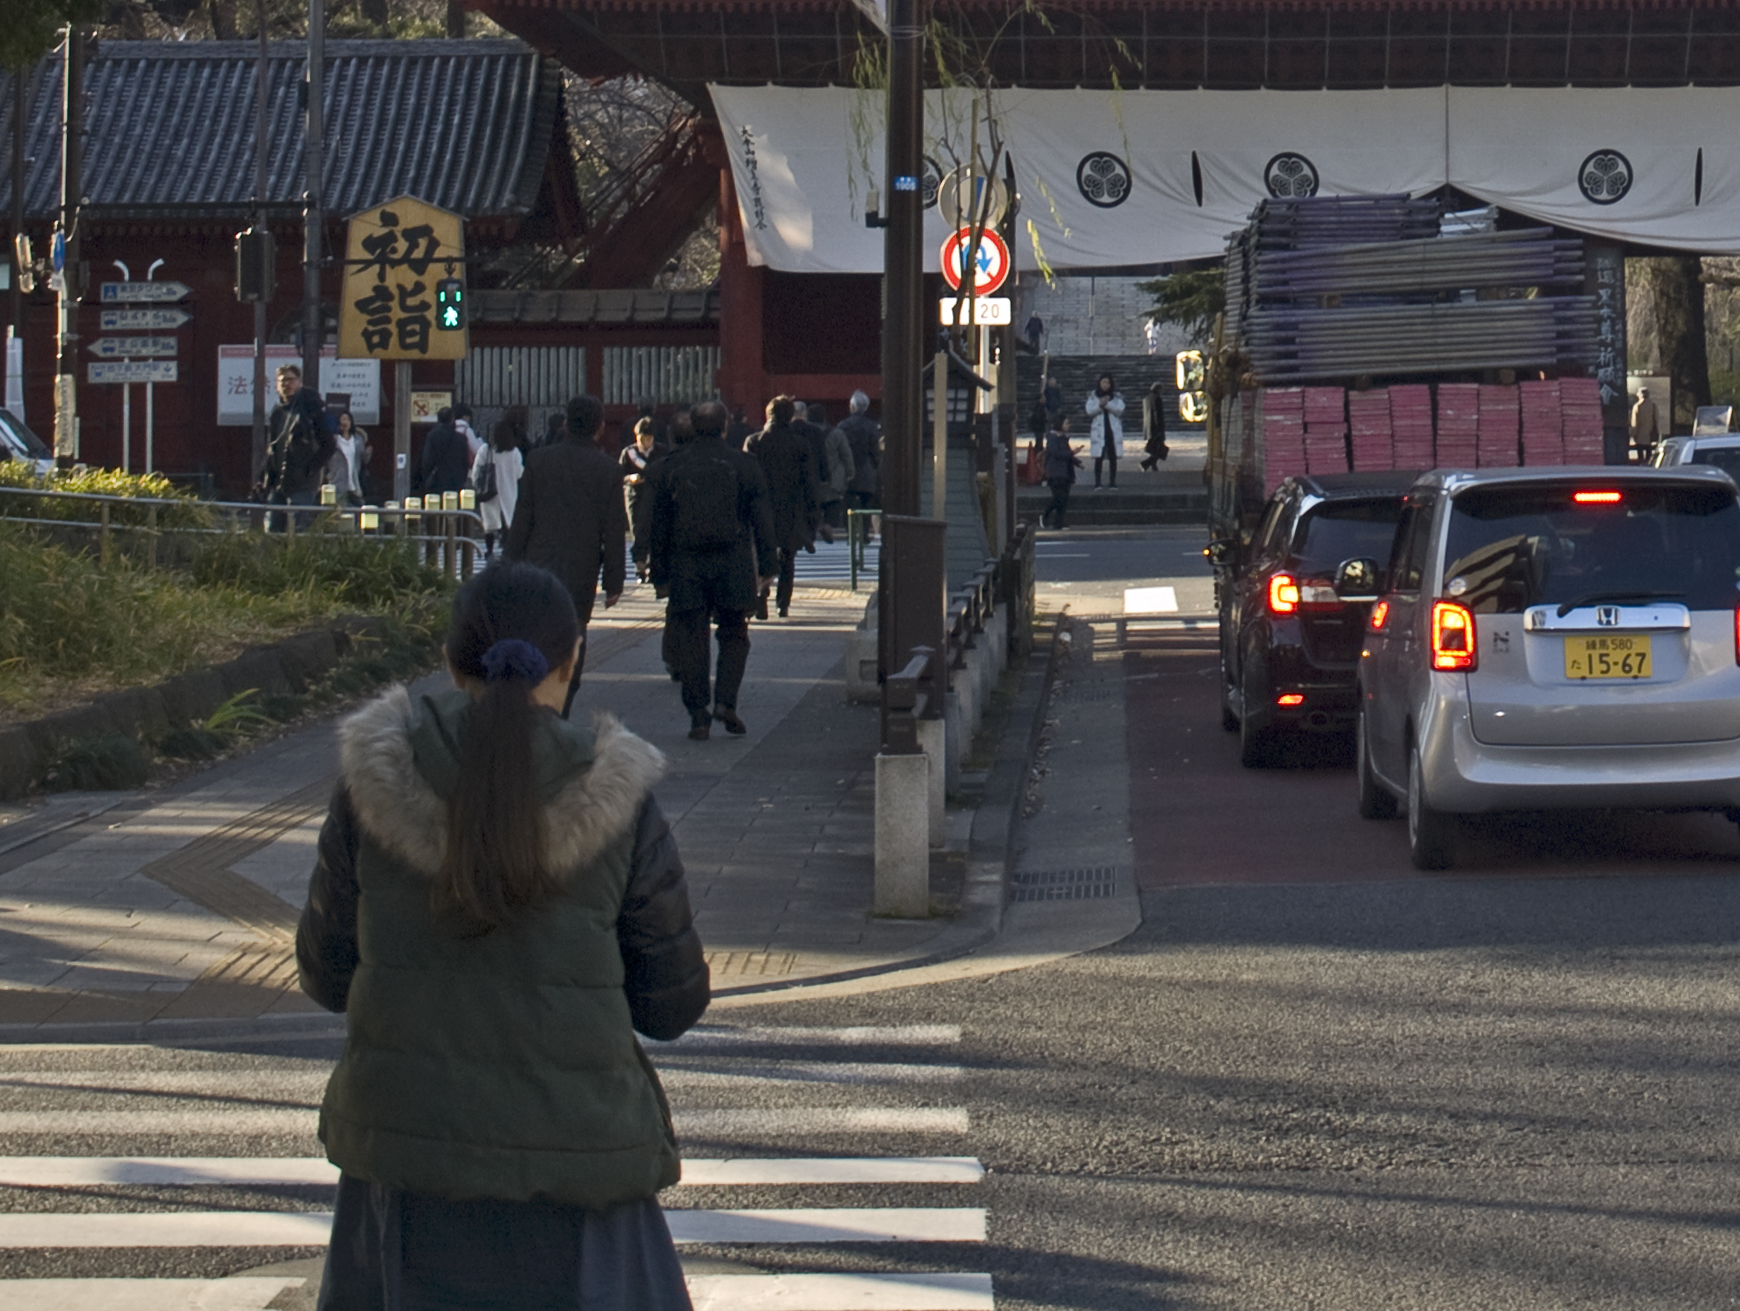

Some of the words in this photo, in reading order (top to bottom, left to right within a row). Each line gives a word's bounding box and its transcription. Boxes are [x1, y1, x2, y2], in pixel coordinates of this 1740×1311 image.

[350, 209, 441, 355] 初詣
[1611, 638, 1633, 650] 580
[1587, 653, 1647, 675] 15-67
